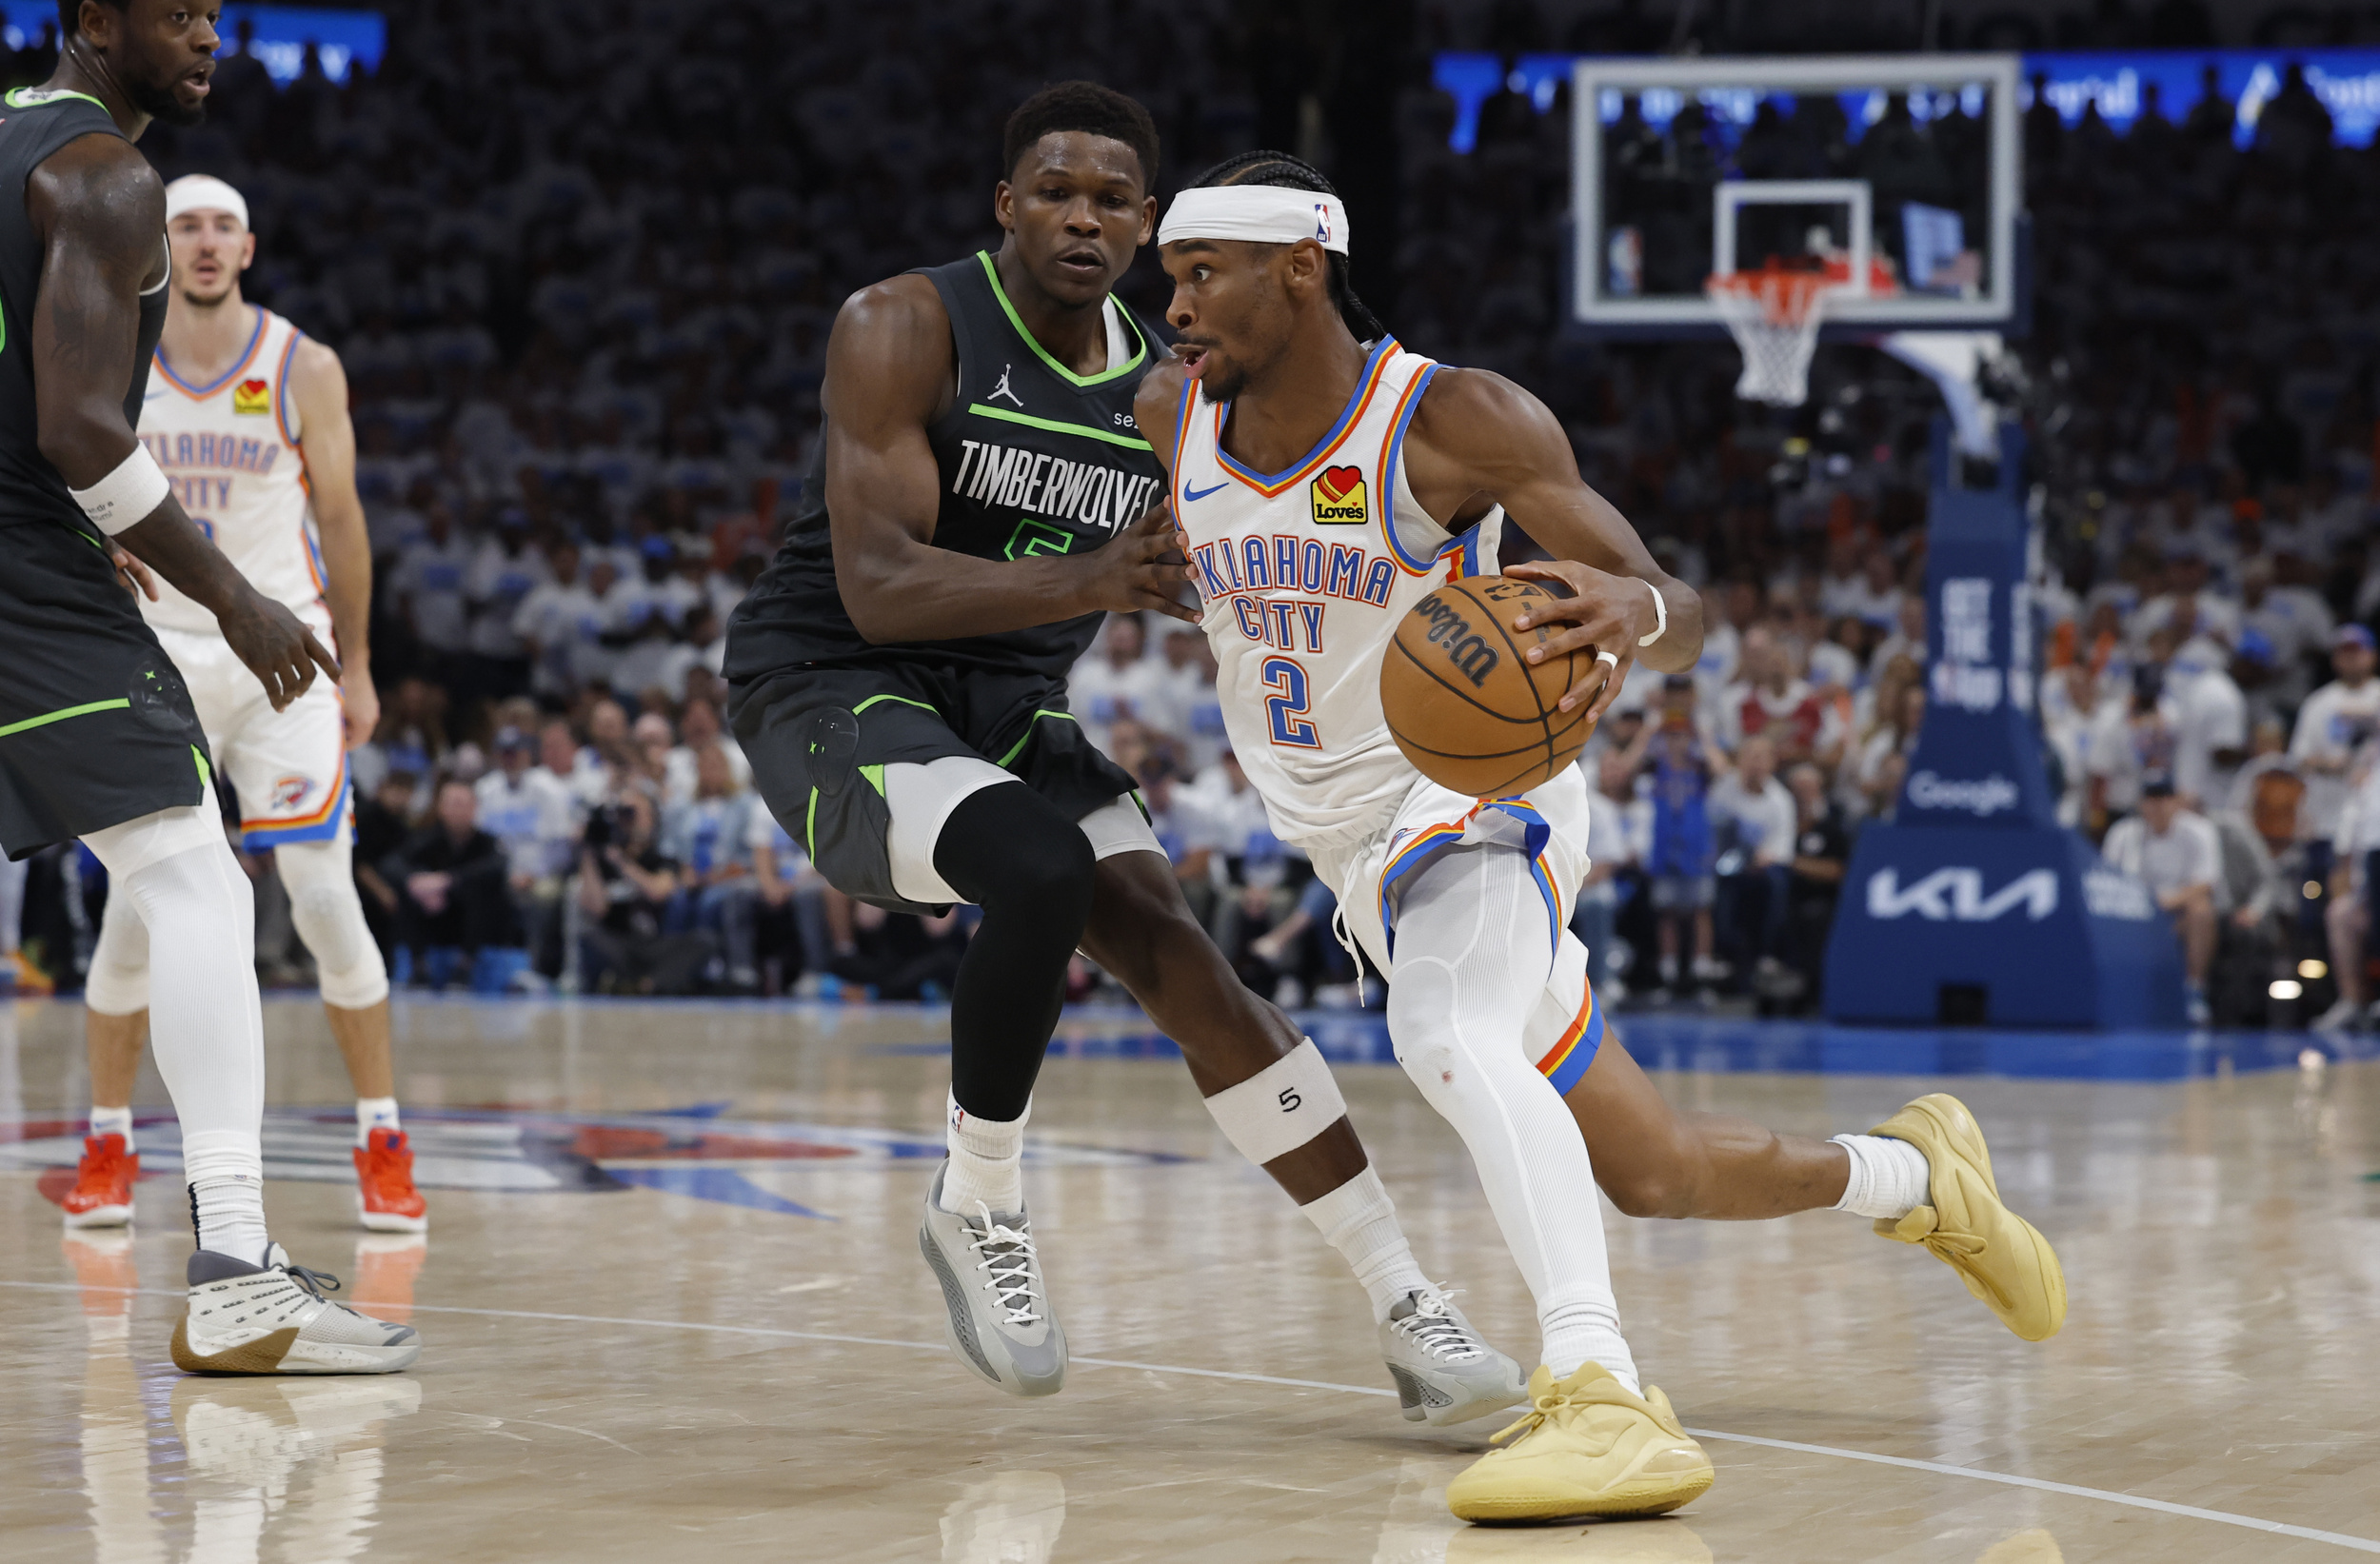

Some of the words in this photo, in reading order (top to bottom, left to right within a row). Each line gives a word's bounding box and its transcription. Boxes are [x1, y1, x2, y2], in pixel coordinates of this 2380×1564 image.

[1114, 412, 1139, 429] se
[138, 432, 280, 474] LAHOMA
[1189, 534, 1397, 609] KLAHOMA
[1231, 595, 1326, 653] CITY
[1261, 655, 1322, 750] 2
[1909, 771, 2018, 815] Google
[1867, 867, 2057, 920] KIA
[1278, 1086, 1301, 1113] 5
